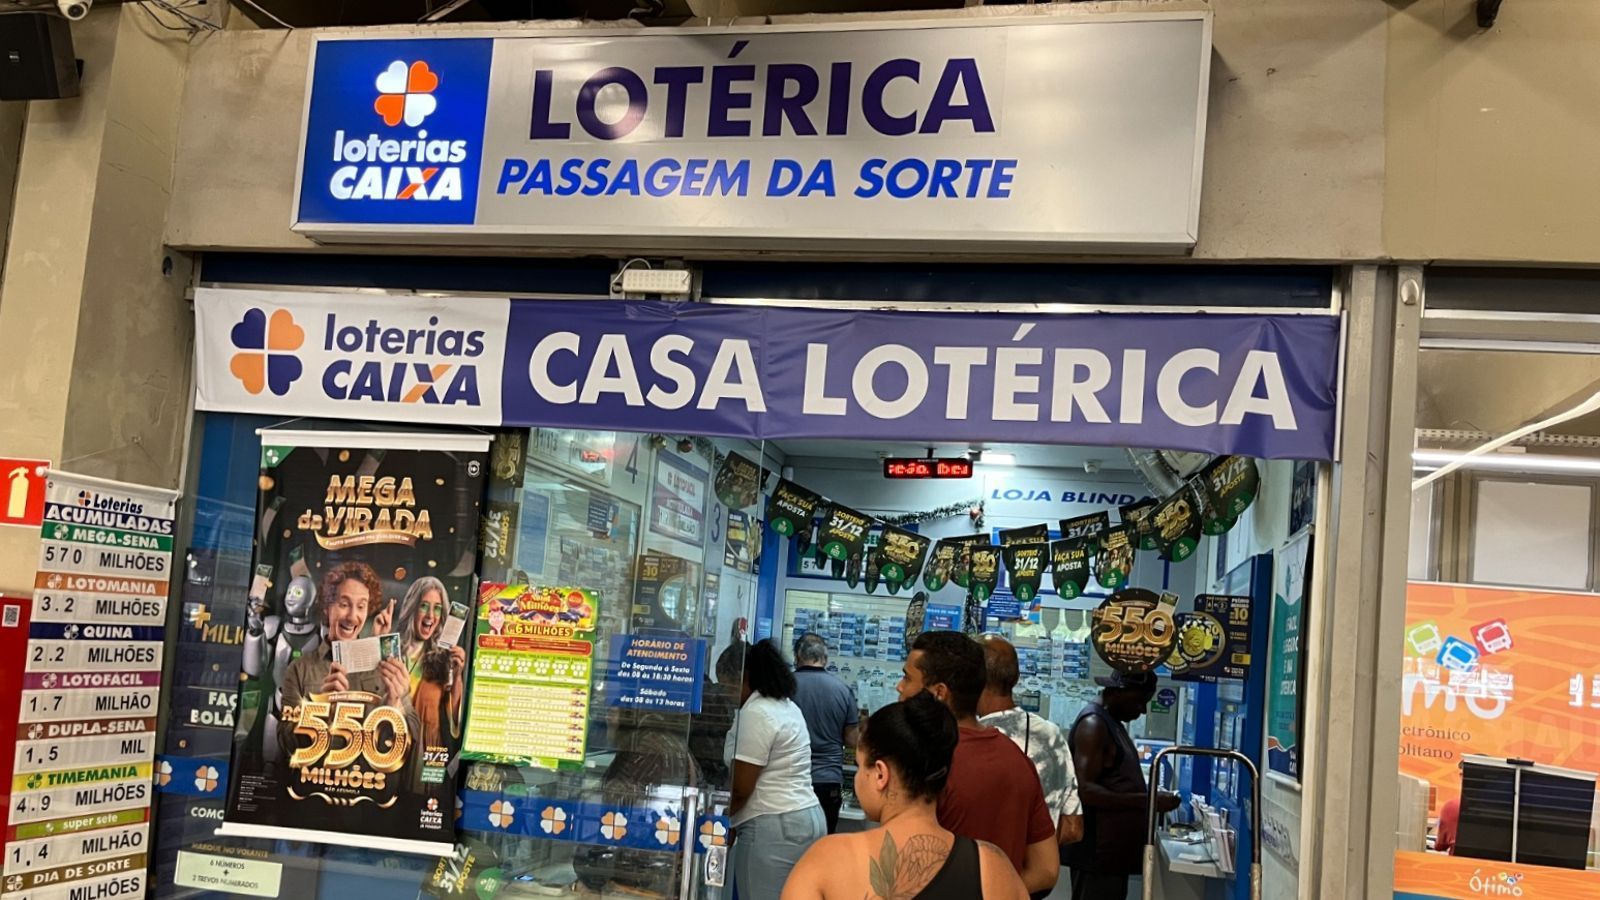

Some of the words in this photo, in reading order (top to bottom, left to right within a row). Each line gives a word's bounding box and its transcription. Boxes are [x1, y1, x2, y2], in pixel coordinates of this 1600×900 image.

[529, 40, 996, 141] LOTÉRICA
[333, 129, 467, 165] loterias
[329, 166, 463, 202] CAIXA
[496, 158, 751, 198] PASSAGEM
[766, 159, 836, 198] DA
[854, 158, 1018, 199] SORTE
[323, 313, 486, 358] loterias
[321, 358, 482, 407] CAIXA
[528, 331, 768, 413] CASA
[801, 322, 1299, 431] LOTÉRICA
[1213, 456, 1248, 492] 31/12
[324, 474, 416, 508] MEGA
[991, 488, 1051, 502] LOJA
[93, 493, 145, 515] Loterias
[776, 499, 808, 518] APOSTA
[46, 504, 172, 534] ACUMULADAS
[297, 509, 323, 531] da
[324, 506, 433, 541] VIRADA
[711, 503, 721, 543] 3
[829, 516, 864, 537] 31/12
[72, 528, 160, 551] MEGA-SENA
[485, 509, 501, 558] 31/12
[1068, 522, 1103, 538] 31/12
[45, 546, 83, 565] 570
[99, 552, 165, 572] MILHÕES
[1014, 557, 1039, 570] 31/12
[1056, 561, 1083, 572] APOSTA
[66, 574, 156, 595] LOTOMANIA
[41, 596, 75, 613] 3.2
[95, 598, 161, 616] MILHÕES
[83, 625, 133, 639] QUINA
[1098, 606, 1174, 646] 550
[33, 646, 65, 662] 2.2
[88, 645, 155, 663] MILHÕES
[631, 638, 672, 649] HORÁRIO
[673, 642, 686, 650] DE
[626, 649, 688, 661] ATENDIMENTO
[617, 670, 630, 678] das
[632, 671, 641, 679] 08
[652, 672, 672, 681] 18:30
[632, 663, 663, 672] Segunda
[671, 665, 690, 673] Sexta
[95, 691, 151, 711] MILHÃO
[620, 695, 633, 703] das
[665, 698, 685, 707] horas
[640, 687, 667, 697] Sábado
[29, 695, 63, 712] 1.7
[48, 720, 146, 737] DUPLA-SENA
[290, 700, 411, 773] 550
[1400, 725, 1471, 742] etrônico
[120, 739, 145, 755] MIL
[422, 751, 449, 762] 31/12
[48, 765, 138, 786] TIMEMANIA
[300, 765, 386, 790] MILHÕES
[16, 795, 51, 813] 4.9
[75, 783, 146, 807] MILHÕES
[63, 816, 94, 831] super
[96, 813, 118, 826] sete
[419, 816, 442, 824] CAIXA
[82, 830, 143, 855] MILHÃO
[33, 869, 60, 885] DIA
[64, 865, 83, 878] DE
[85, 858, 130, 876] SORTE
[439, 843, 469, 894] 31/2
[1469, 868, 1523, 898] Ótimo
